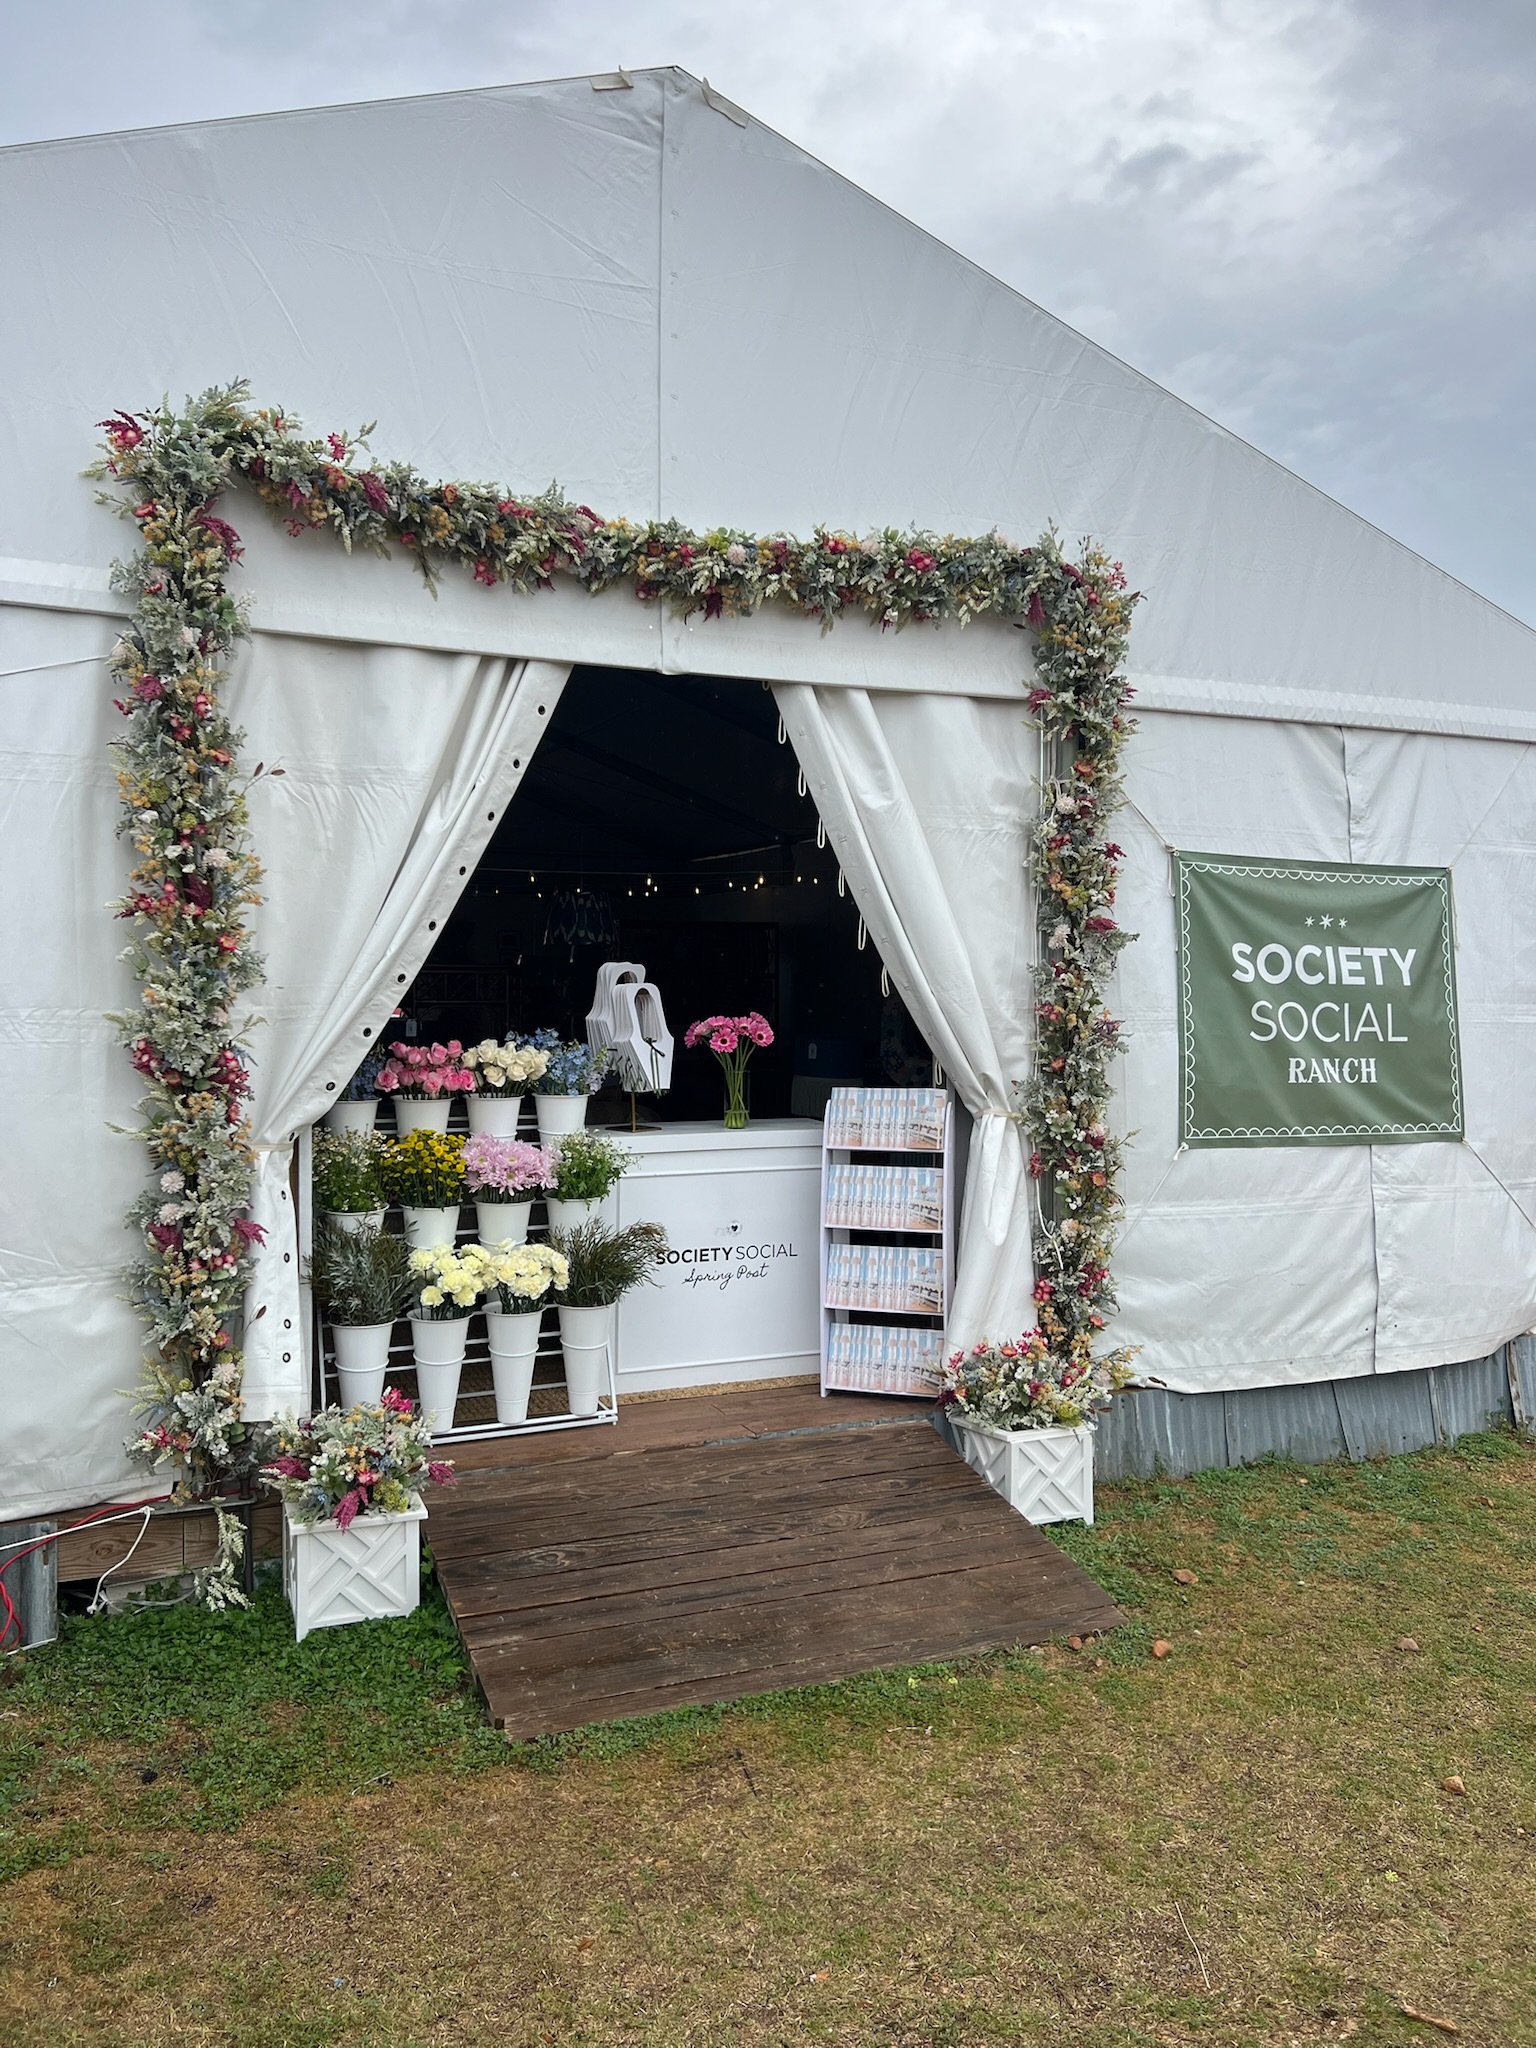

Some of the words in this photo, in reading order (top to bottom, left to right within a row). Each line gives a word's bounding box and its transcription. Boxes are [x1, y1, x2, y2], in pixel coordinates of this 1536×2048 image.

[1231, 942, 1416, 986] SOCIETY
[1250, 1000, 1408, 1042] SOCIAL
[1287, 1057, 1378, 1084] RANCH
[656, 1246, 733, 1265] SOCIETY
[735, 1243, 798, 1260] SOCIAL
[682, 1268, 734, 1290] Spring
[736, 1262, 769, 1279] Post
